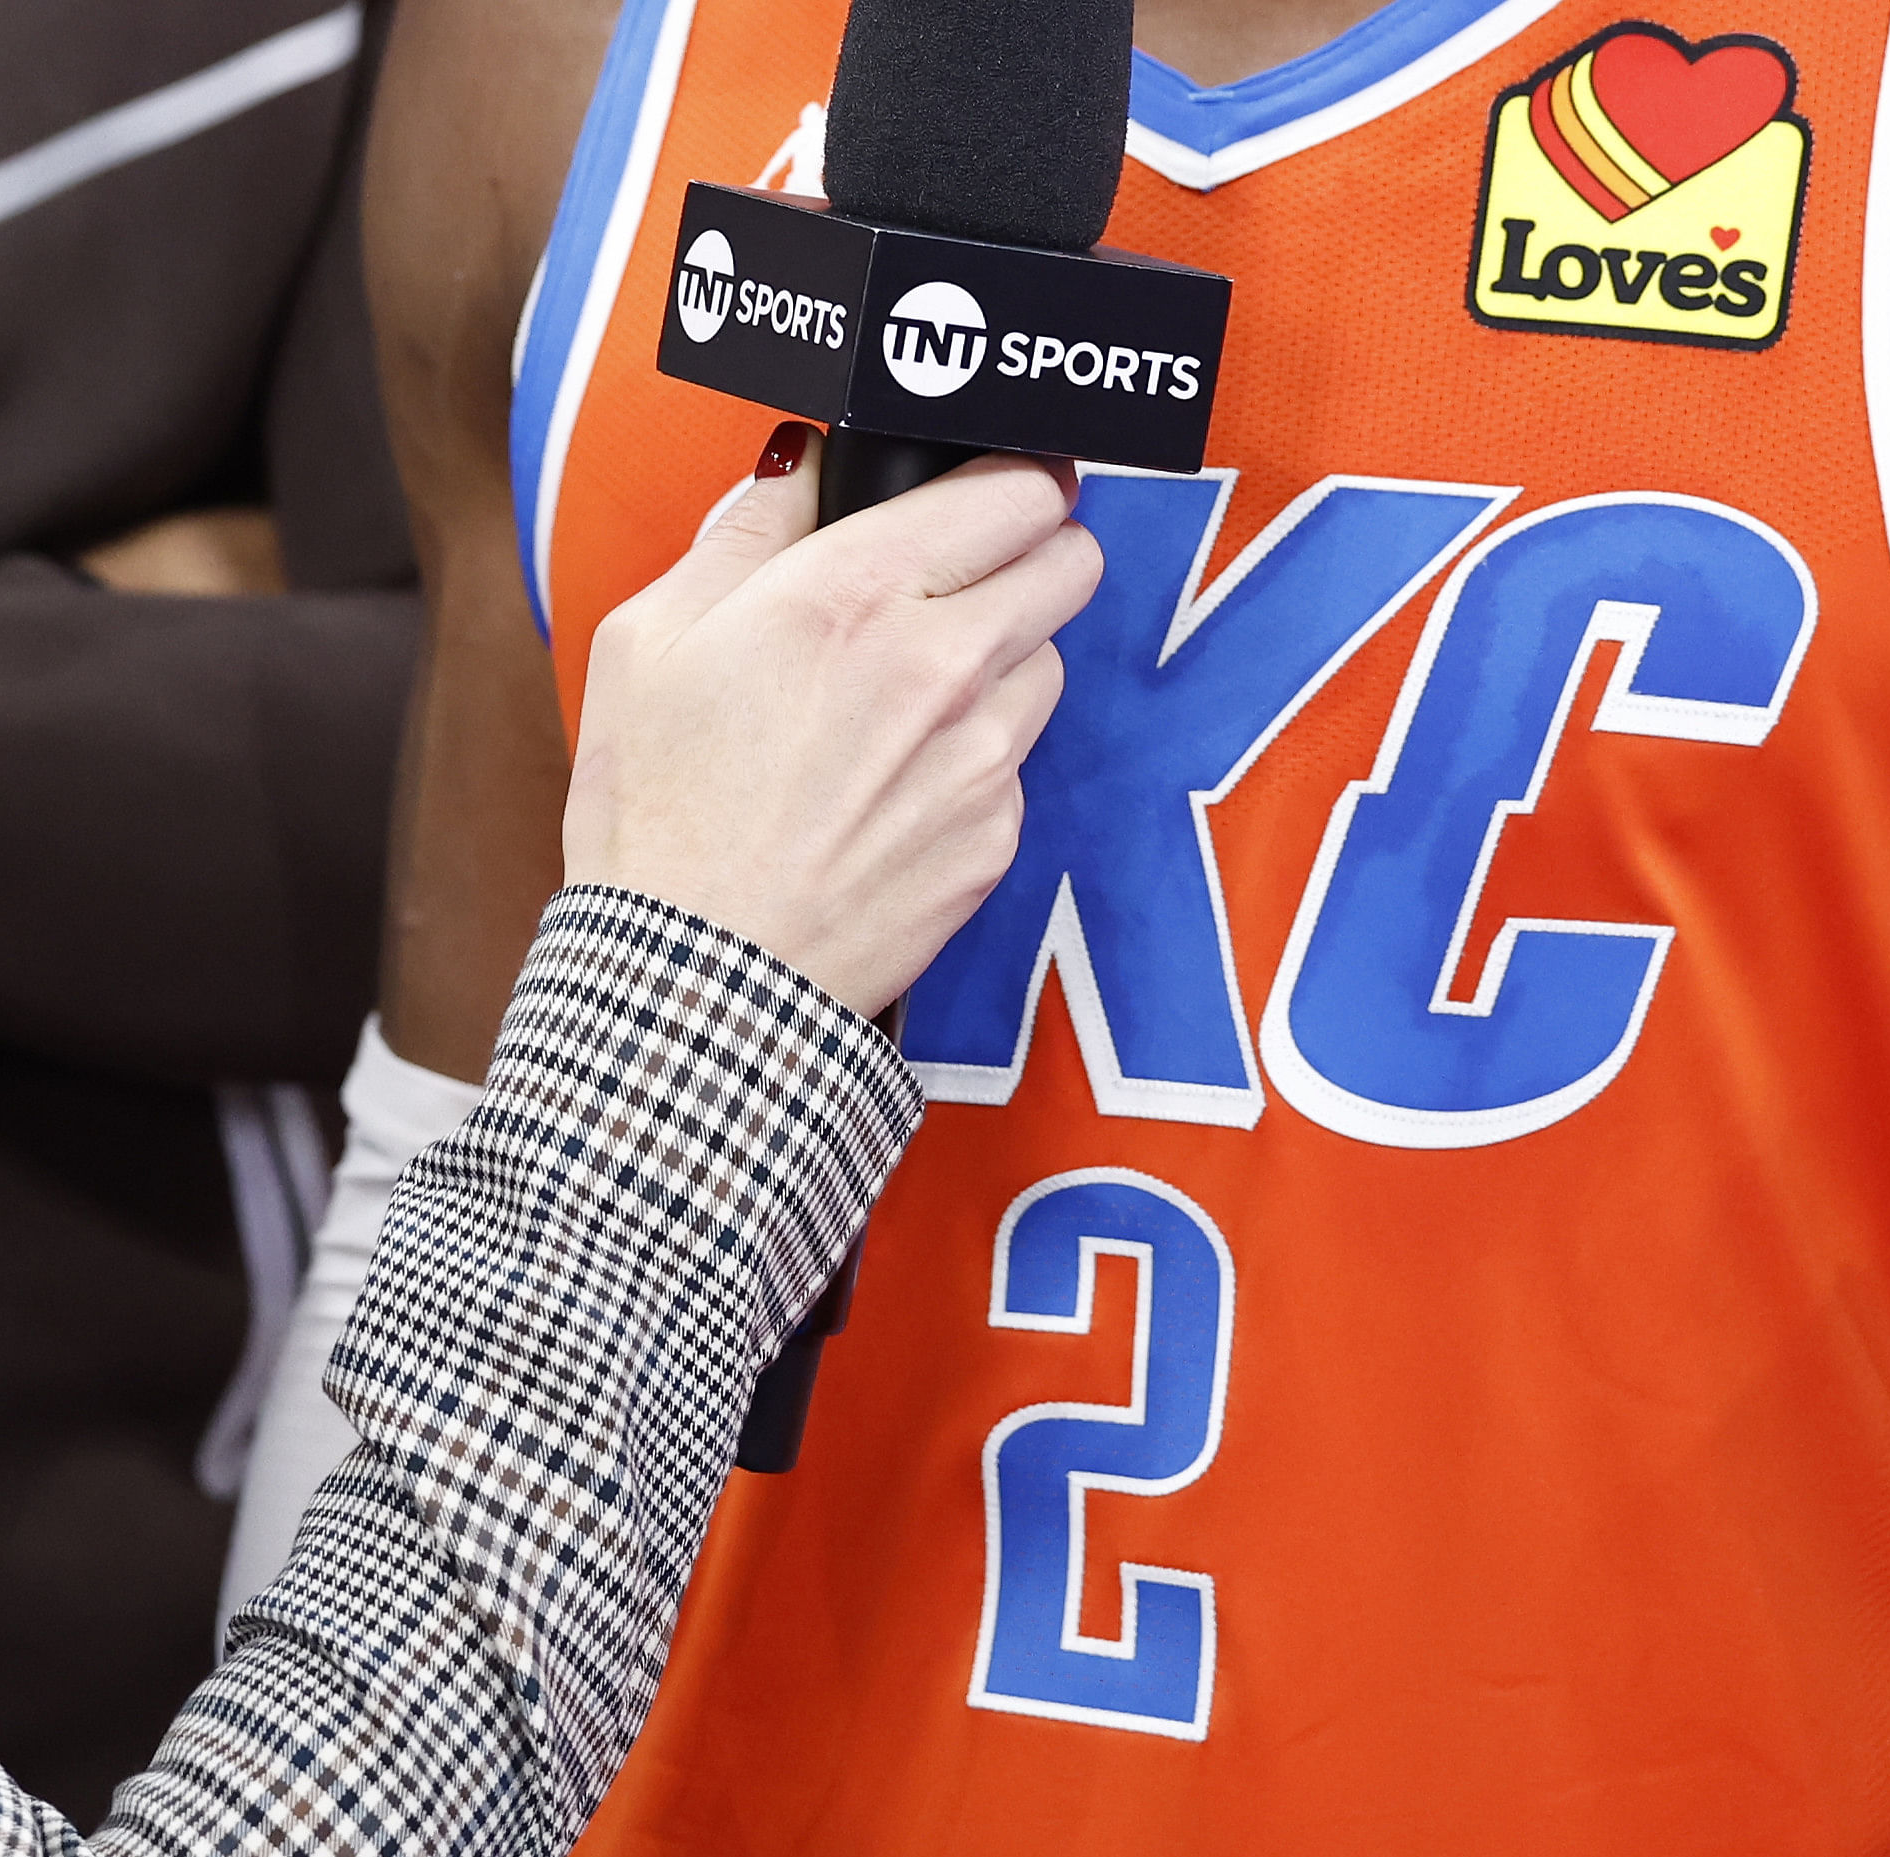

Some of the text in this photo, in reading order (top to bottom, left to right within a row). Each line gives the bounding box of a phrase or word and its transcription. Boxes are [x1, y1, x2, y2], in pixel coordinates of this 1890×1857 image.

[734, 278, 848, 351] SPORTS
[1489, 216, 1769, 319] Loves
[995, 330, 1202, 401] SPORTS
[699, 466, 1819, 1151] KC
[966, 1165, 1236, 1744] 2
